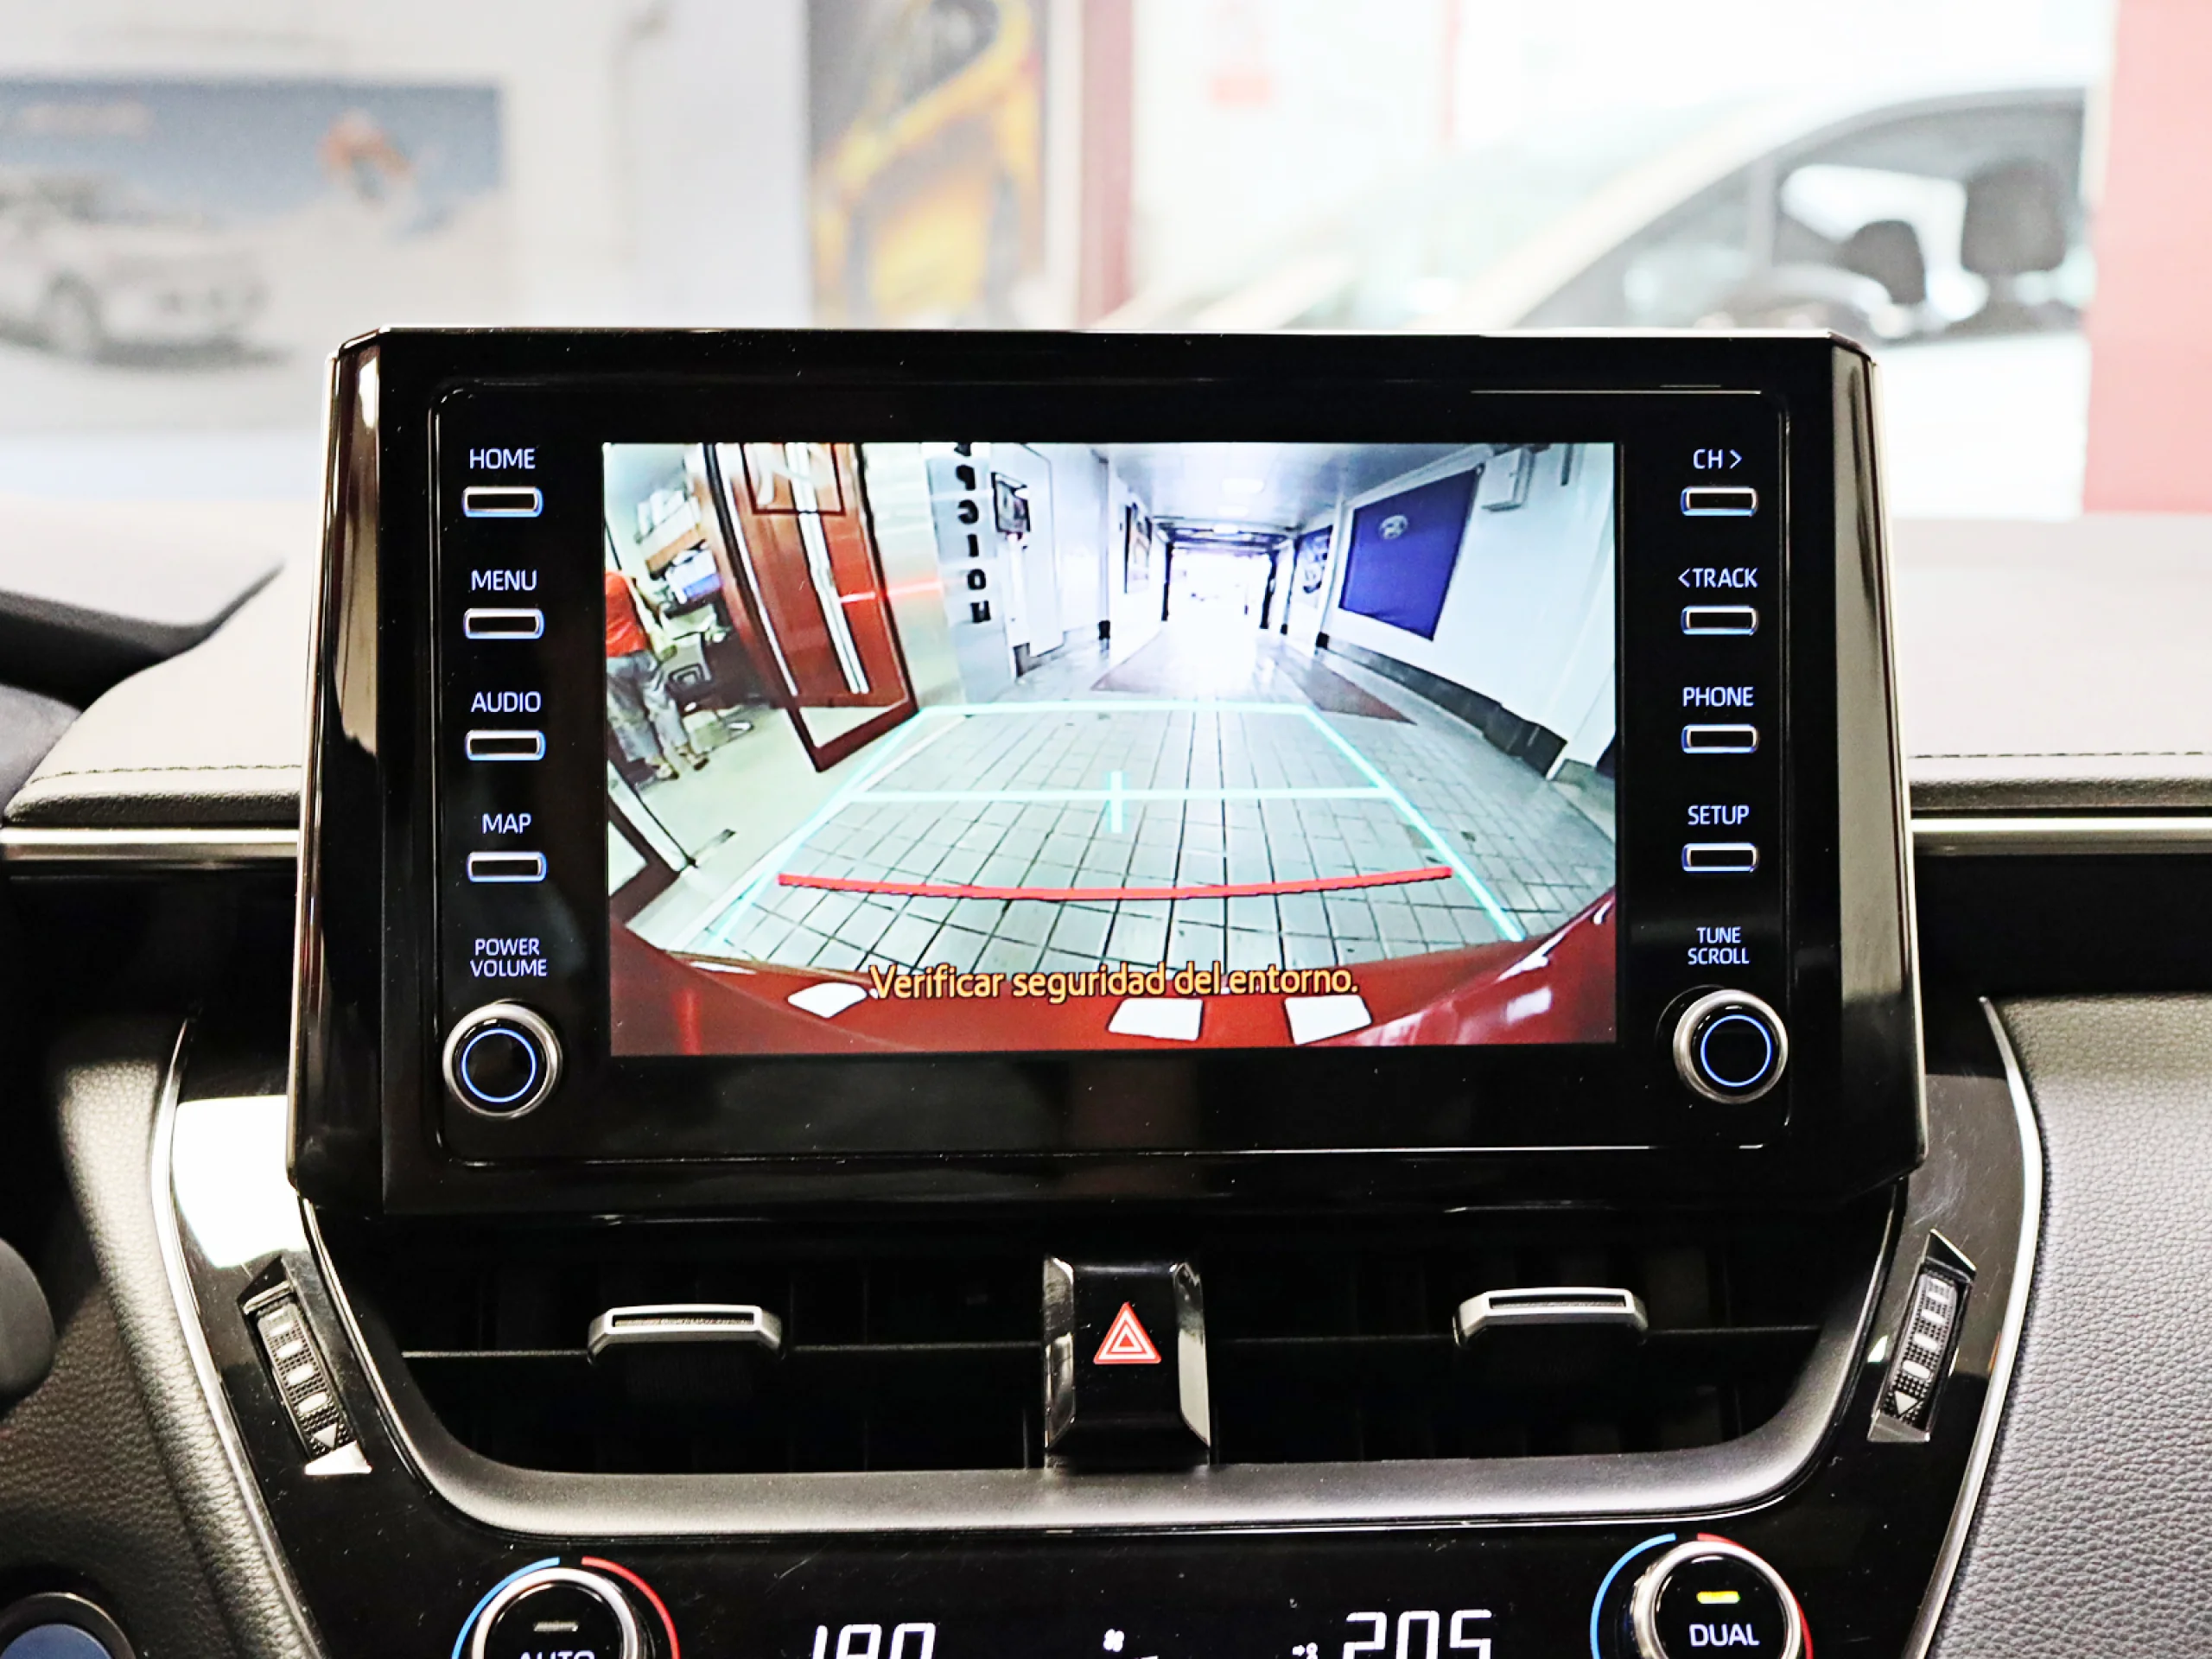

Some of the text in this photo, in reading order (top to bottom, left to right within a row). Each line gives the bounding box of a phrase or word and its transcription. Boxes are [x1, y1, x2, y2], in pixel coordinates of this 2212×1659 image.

[469, 448, 536, 469] HOME
[1693, 448, 1724, 469] CH
[471, 569, 537, 591] MENU
[470, 690, 542, 713] AUDIO
[1682, 686, 1754, 708] PHONE
[481, 812, 532, 835] MAP
[1688, 804, 1750, 826] SETUP
[1695, 925, 1742, 944] TUNE
[474, 938, 540, 957] POWER
[1688, 947, 1750, 965] SCROLL
[469, 958, 548, 978] VOLUME
[869, 960, 1359, 1004] Verificar seguridad del entorno.
[1689, 1624, 1760, 1647] DUAL
